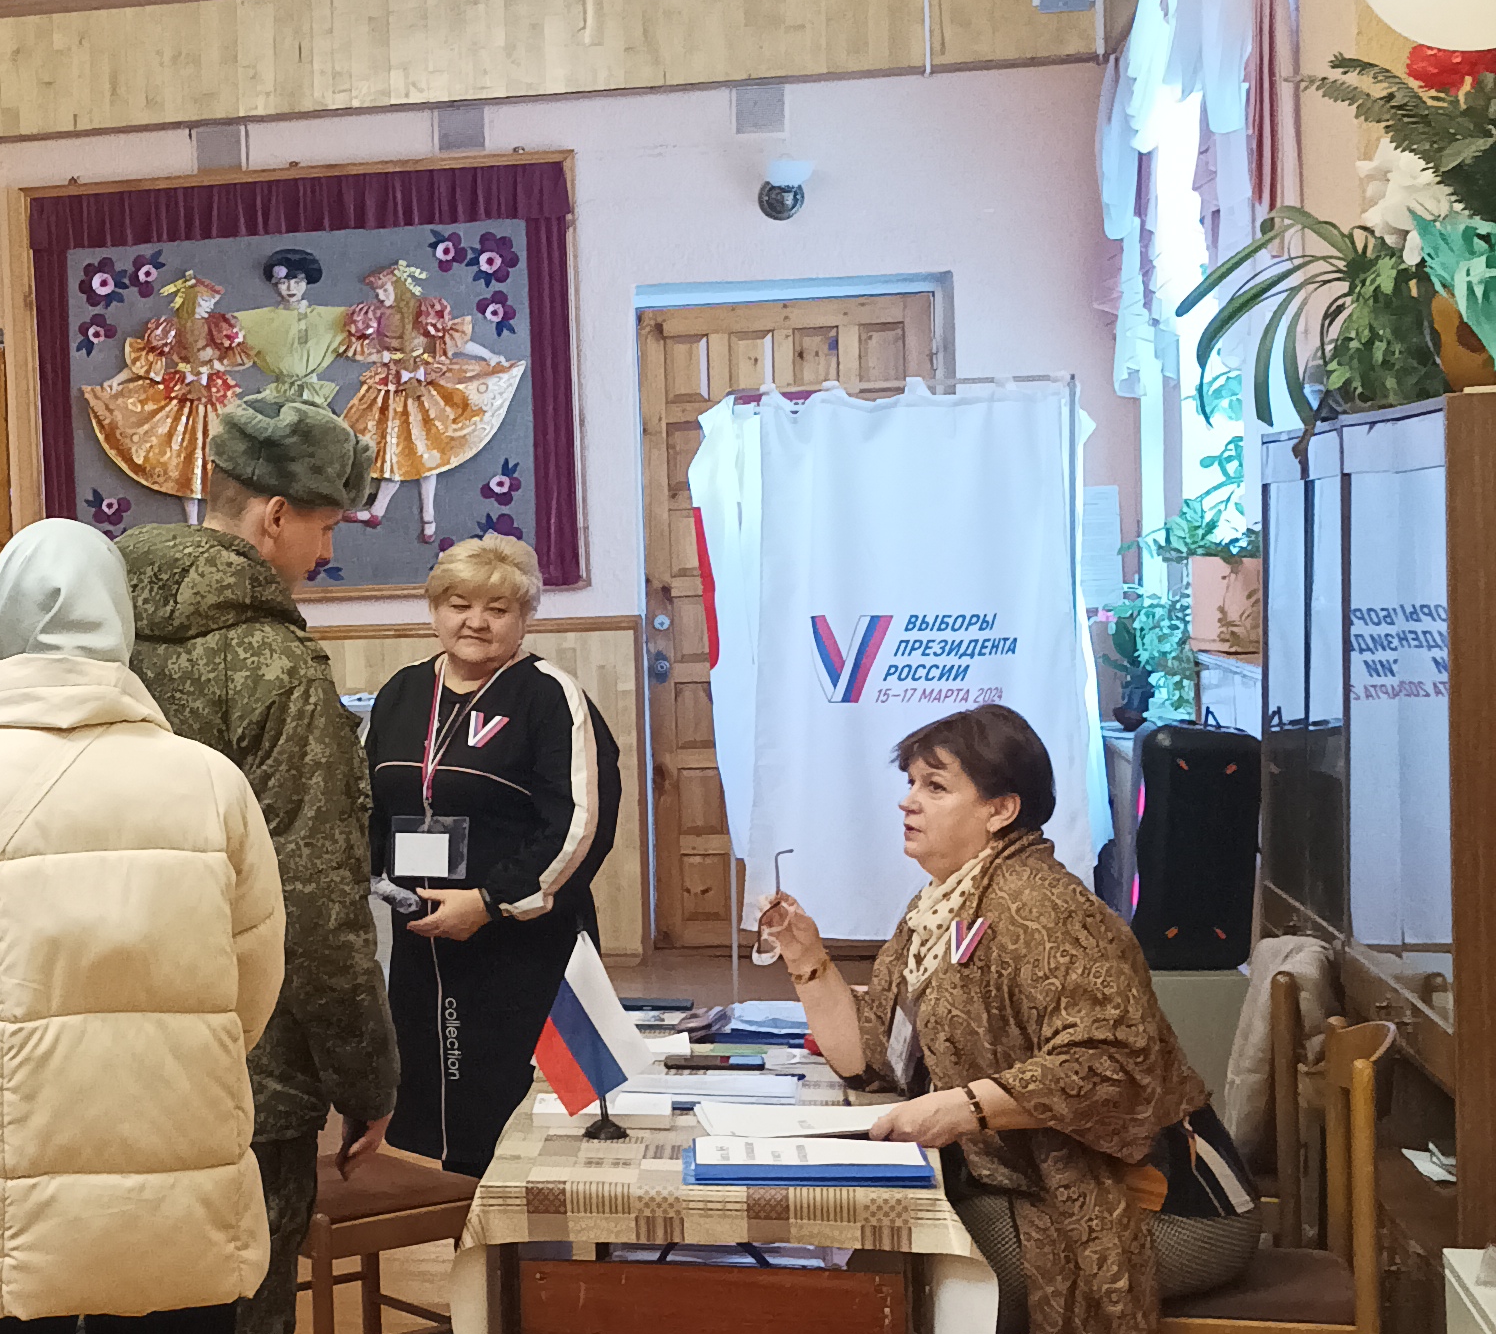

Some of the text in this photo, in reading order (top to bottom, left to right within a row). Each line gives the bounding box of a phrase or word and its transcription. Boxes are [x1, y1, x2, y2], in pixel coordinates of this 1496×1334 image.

[903, 612, 997, 632] ВЫБОРЫ
[893, 637, 1018, 660] ПРЕЗИДЕНТА
[882, 664, 970, 682] РОССИИ
[918, 688, 970, 704] МАРТА
[973, 686, 1004, 704] 2024
[445, 997, 462, 1080] collection
